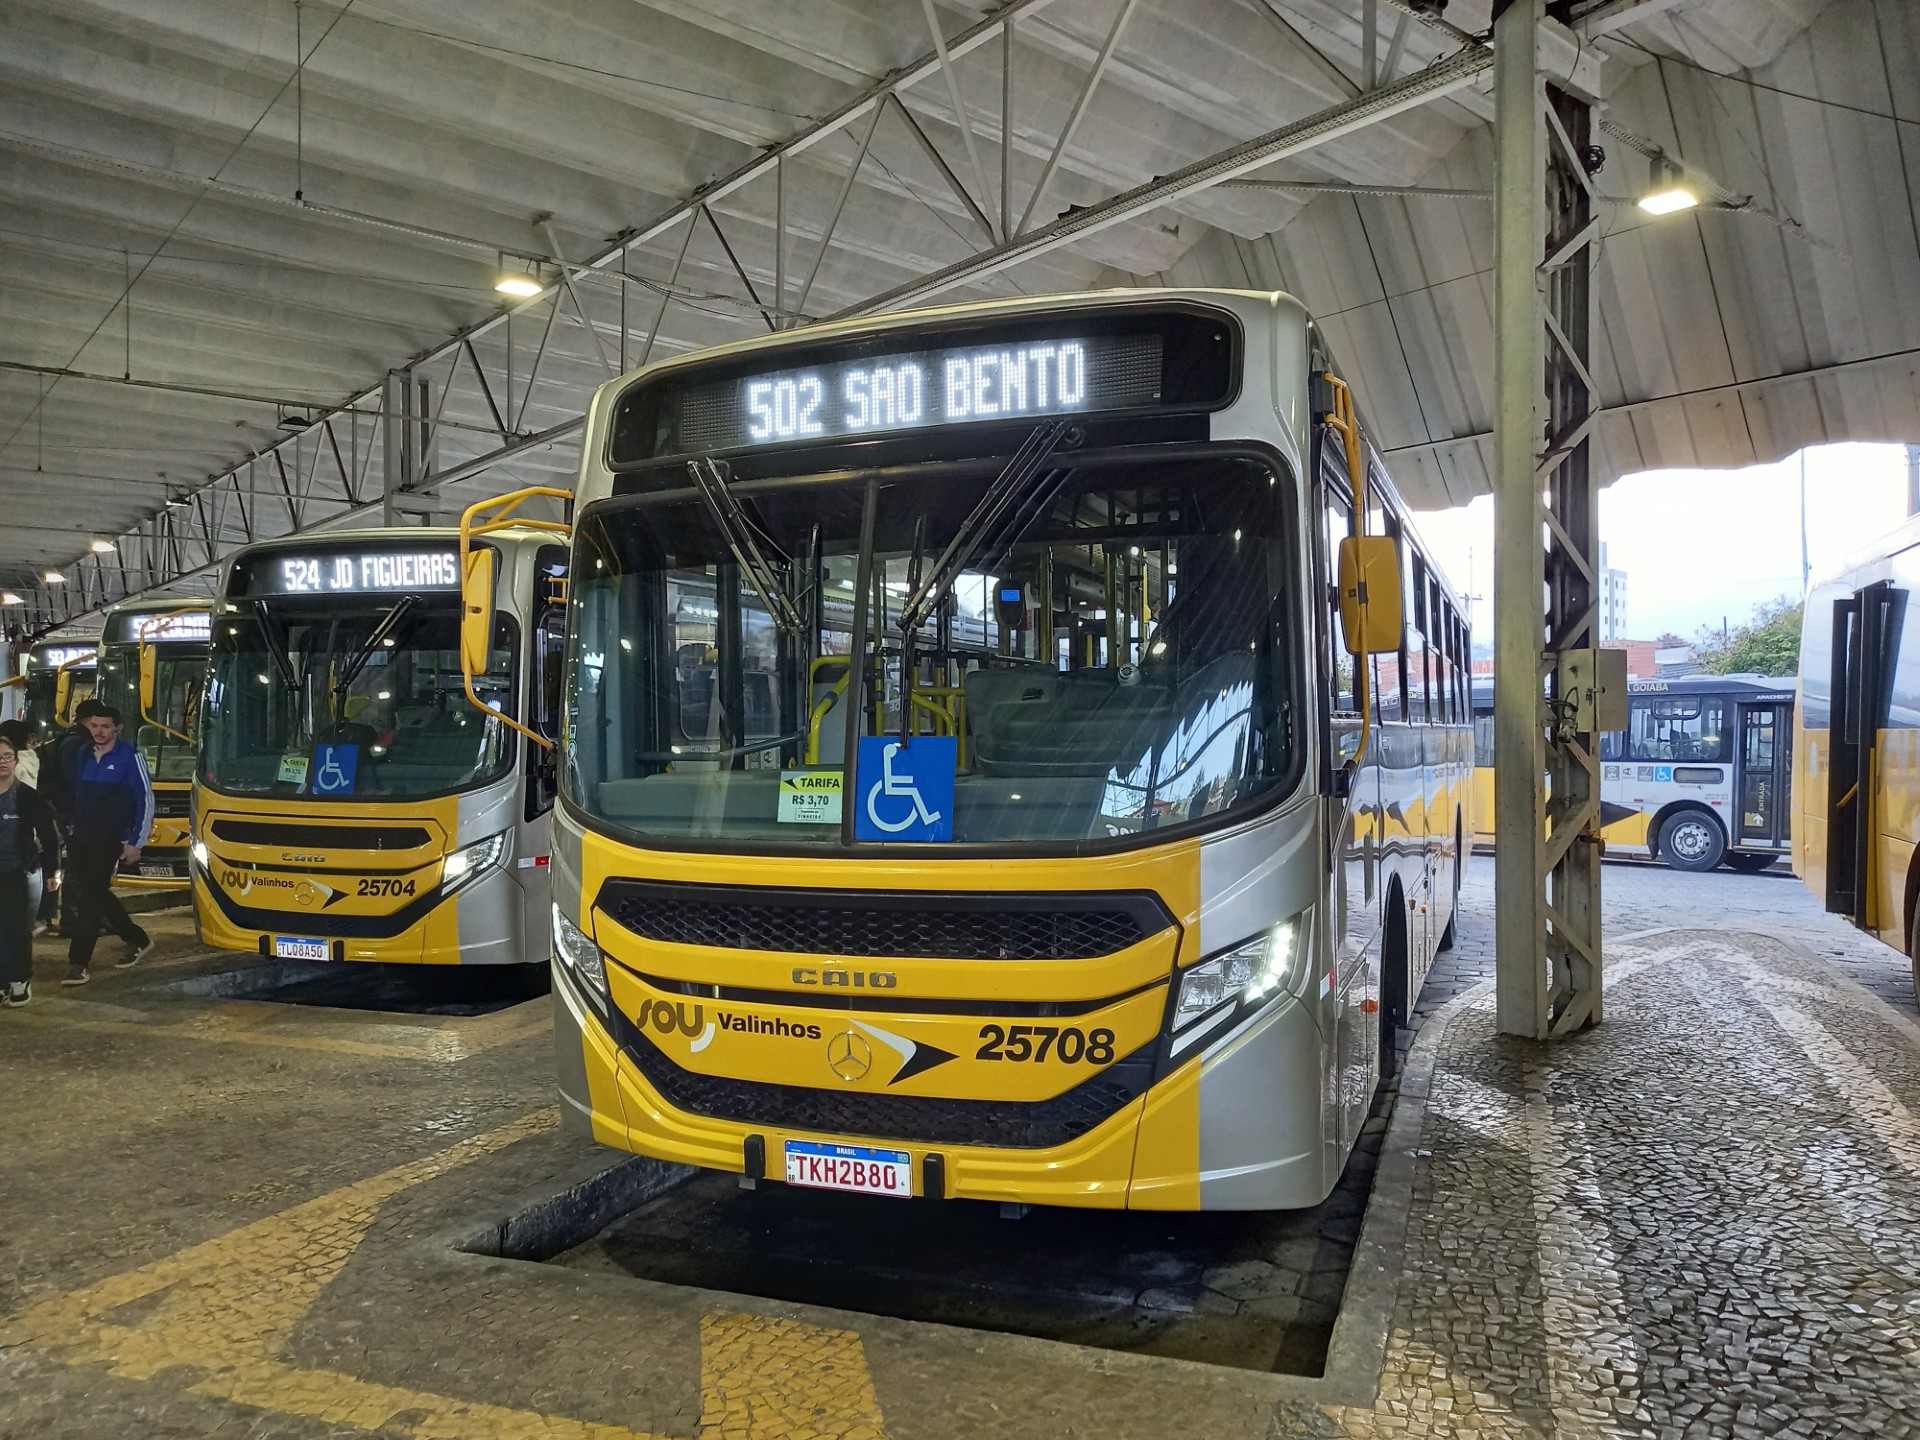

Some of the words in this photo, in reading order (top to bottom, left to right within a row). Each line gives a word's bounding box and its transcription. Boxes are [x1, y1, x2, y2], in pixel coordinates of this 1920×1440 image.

[749, 376, 823, 438] 502
[845, 364, 922, 428] SAO
[945, 343, 1086, 417] BENTO
[284, 559, 321, 591] 524
[330, 557, 353, 589] JD
[361, 553, 456, 588] FIGUEIRAS
[1632, 682, 1669, 692] GOIABA
[800, 778, 840, 788] TARIFA
[791, 795, 805, 805] R$
[807, 795, 829, 807] 3,70
[1758, 781, 1766, 811] ENTRADA
[281, 852, 326, 862] CAIO
[251, 876, 295, 889] Valinhos
[356, 879, 416, 897] 25704
[792, 968, 897, 988] CAIO
[717, 1012, 822, 1040] Valinhos
[975, 1024, 1115, 1065] 25708
[836, 1147, 857, 1156] BRASIL
[795, 1155, 897, 1190] TKH2B80
